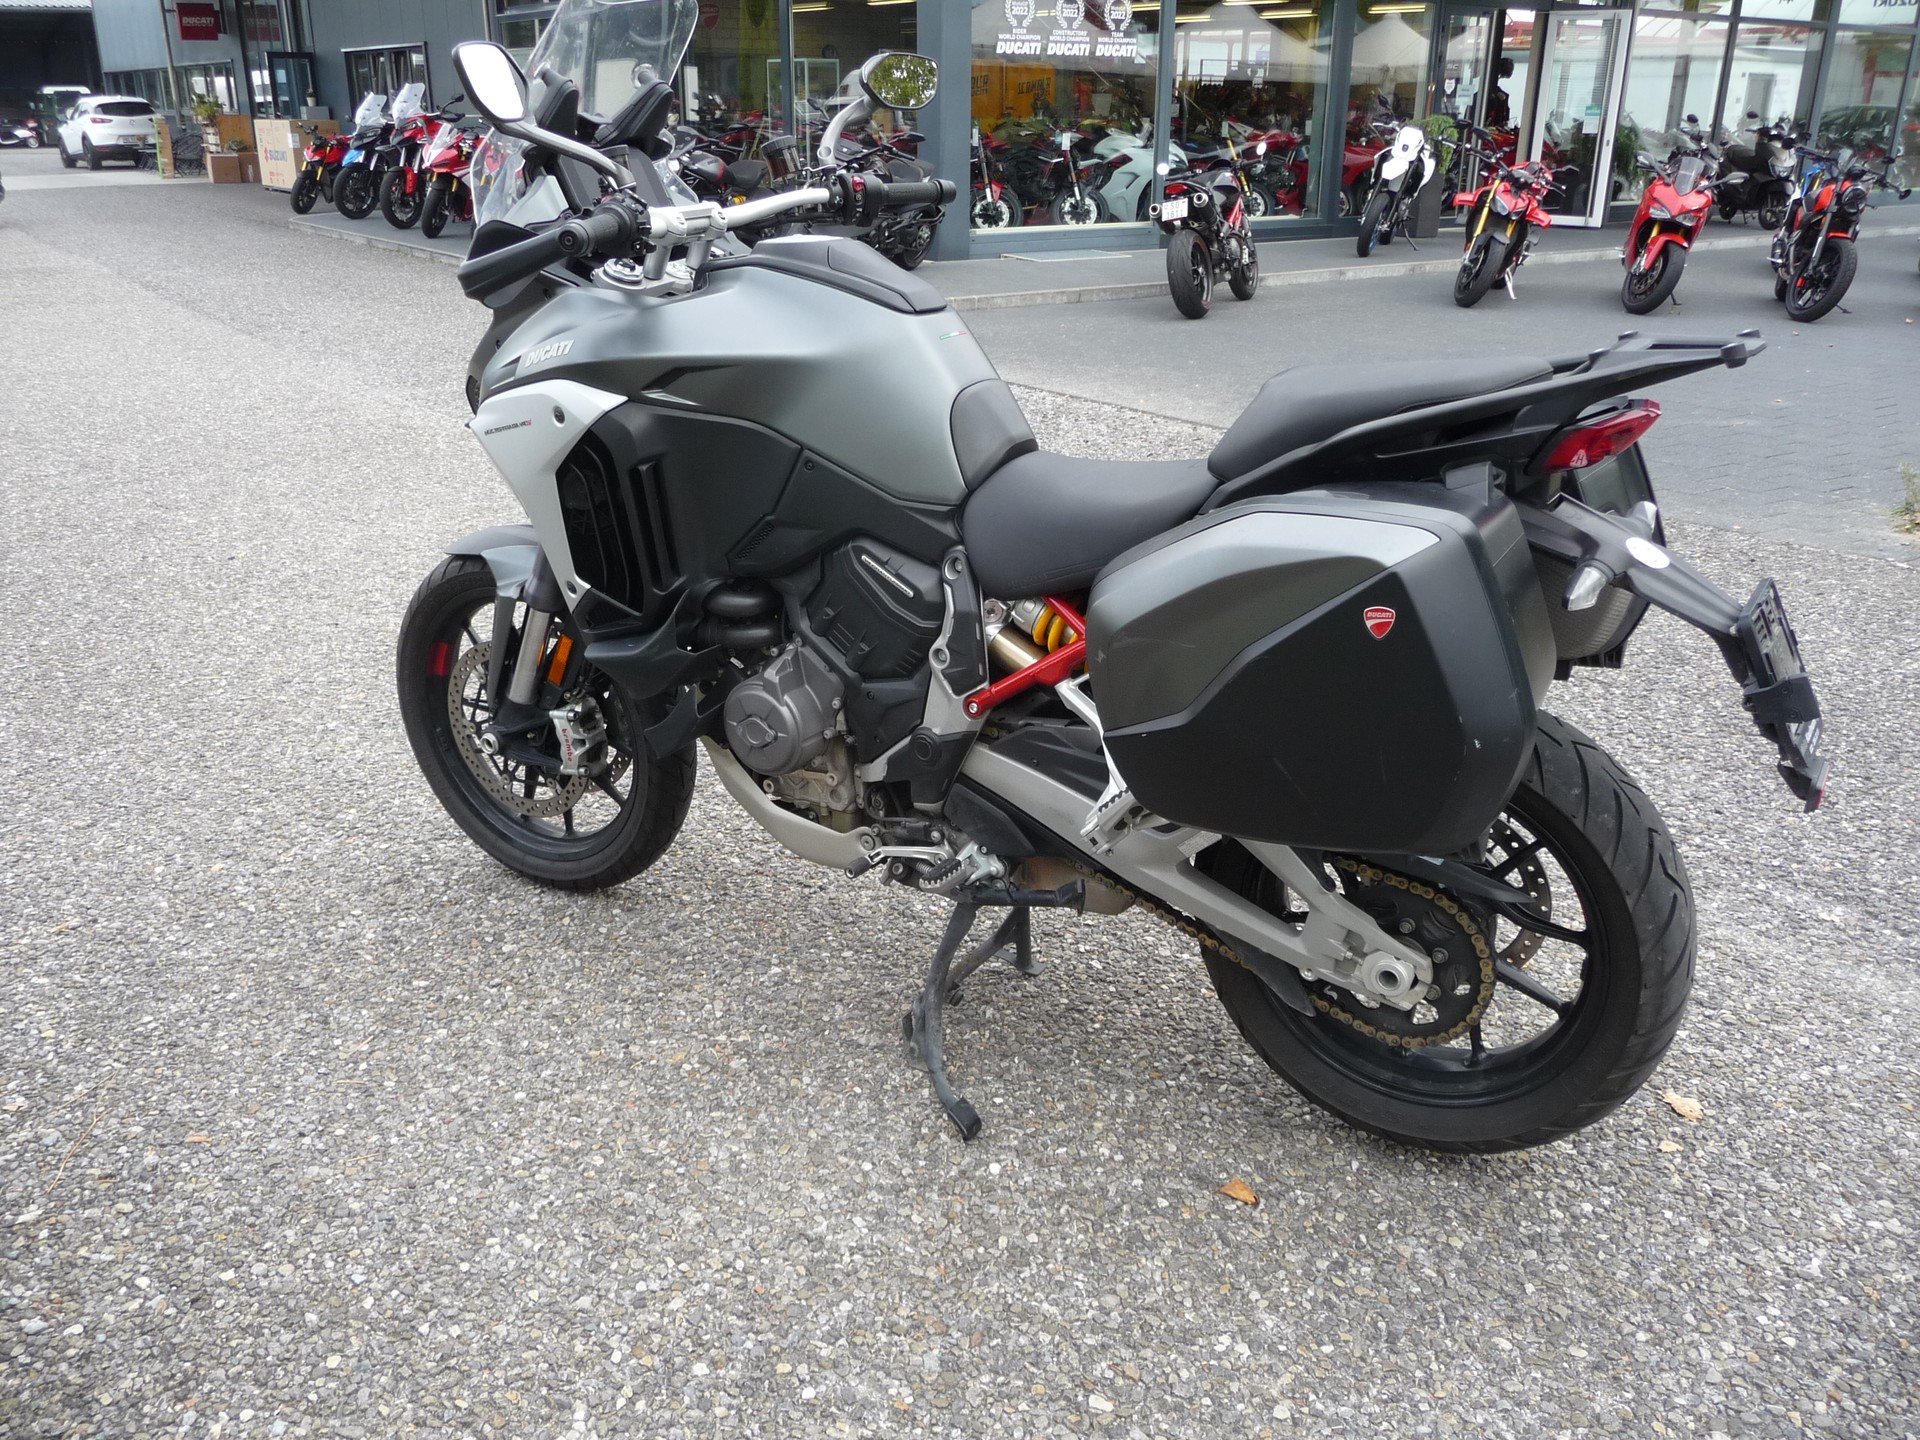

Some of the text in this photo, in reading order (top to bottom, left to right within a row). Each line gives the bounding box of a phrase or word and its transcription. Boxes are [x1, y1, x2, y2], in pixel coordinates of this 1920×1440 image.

[1011, 6, 1028, 15] 2022
[1062, 8, 1078, 18] 2022
[1110, 10, 1126, 20] 2022
[182, 16, 214, 25] DUCATI
[996, 41, 1041, 55] DUCATI
[1047, 42, 1090, 56] DUCATI
[1095, 44, 1137, 57] DUCATI
[524, 339, 575, 368] DUCATI
[1367, 611, 1393, 619] DUCATI
[561, 728, 572, 761] brembo
